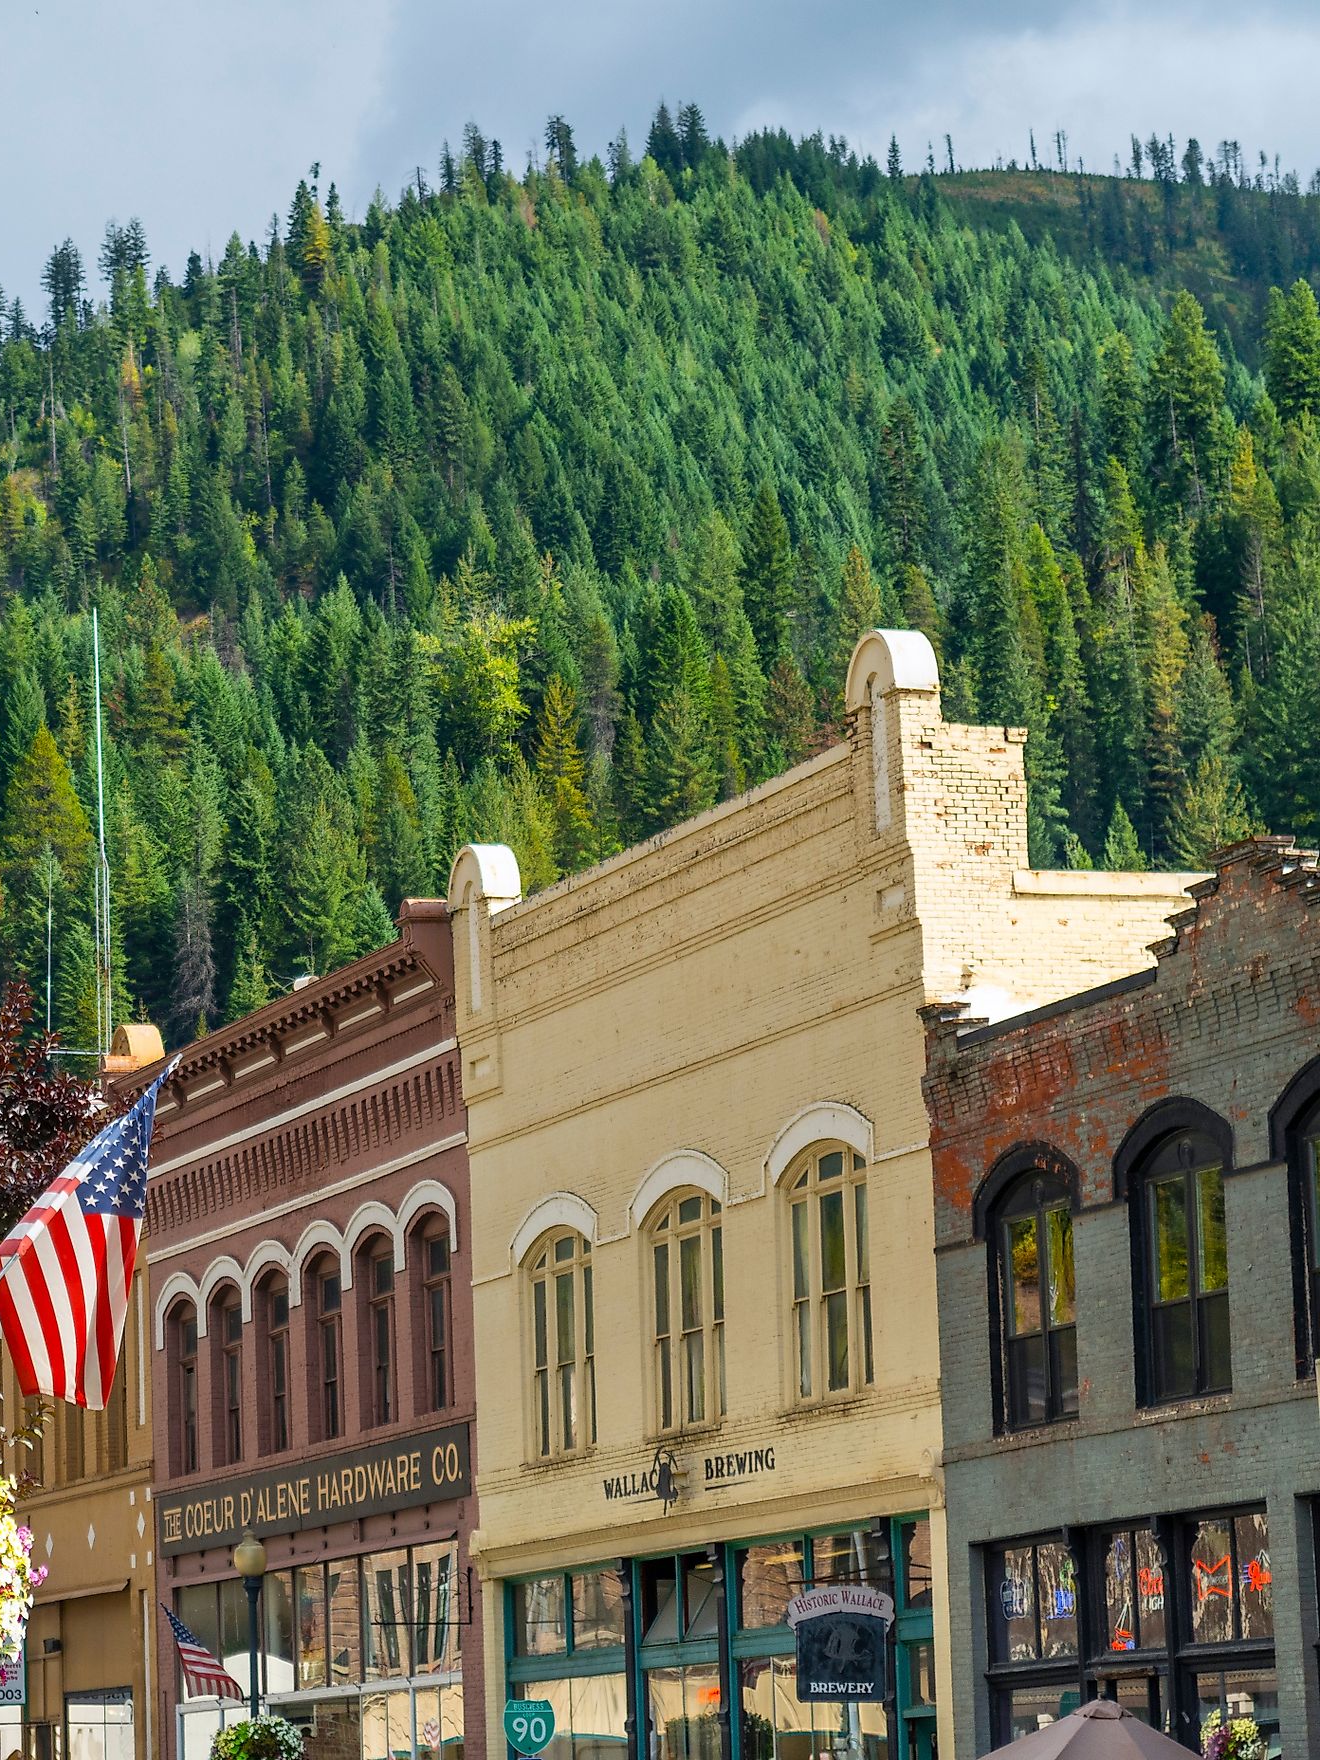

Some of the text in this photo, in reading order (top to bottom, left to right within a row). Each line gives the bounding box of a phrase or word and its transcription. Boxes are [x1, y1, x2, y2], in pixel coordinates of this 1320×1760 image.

[603, 1447, 776, 1500] WALLAC BREWING
[164, 1442, 463, 1538] THE COEUR D'ALENE HARDWARE CO.
[1143, 1596, 1164, 1610] LIGH
[810, 1682, 874, 1694] BREWERY
[512, 1718, 546, 1743] 90
